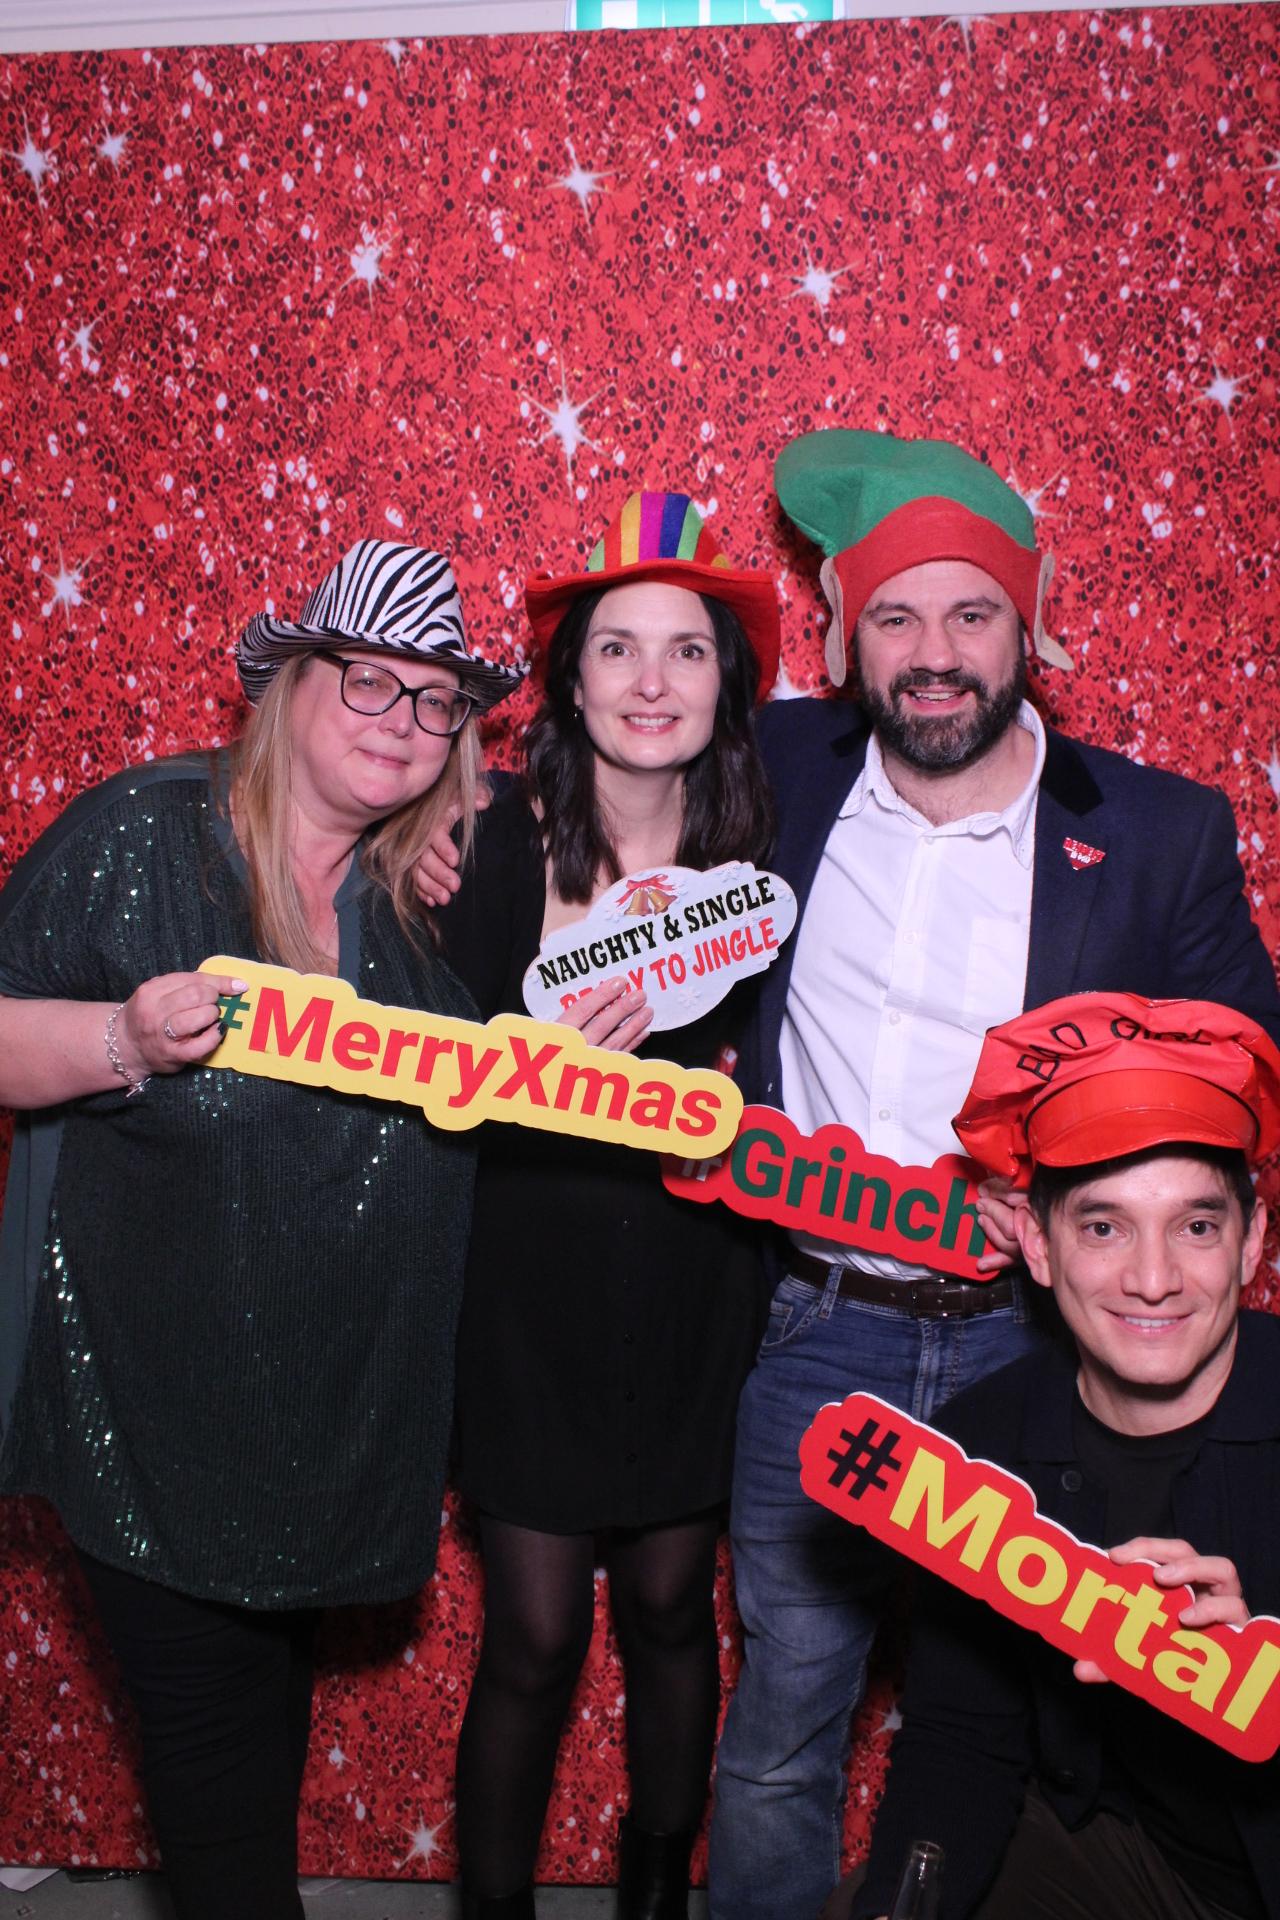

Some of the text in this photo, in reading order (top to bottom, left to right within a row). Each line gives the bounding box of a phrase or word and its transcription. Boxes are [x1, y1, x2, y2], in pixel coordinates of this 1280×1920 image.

[537, 921, 657, 989] NAUGHTY
[663, 914, 683, 942] &
[685, 876, 776, 934] SINGLE
[650, 952, 687, 991] TO
[692, 917, 779, 976] JINGLE
[826, 1418, 1280, 1732] #Mortal
